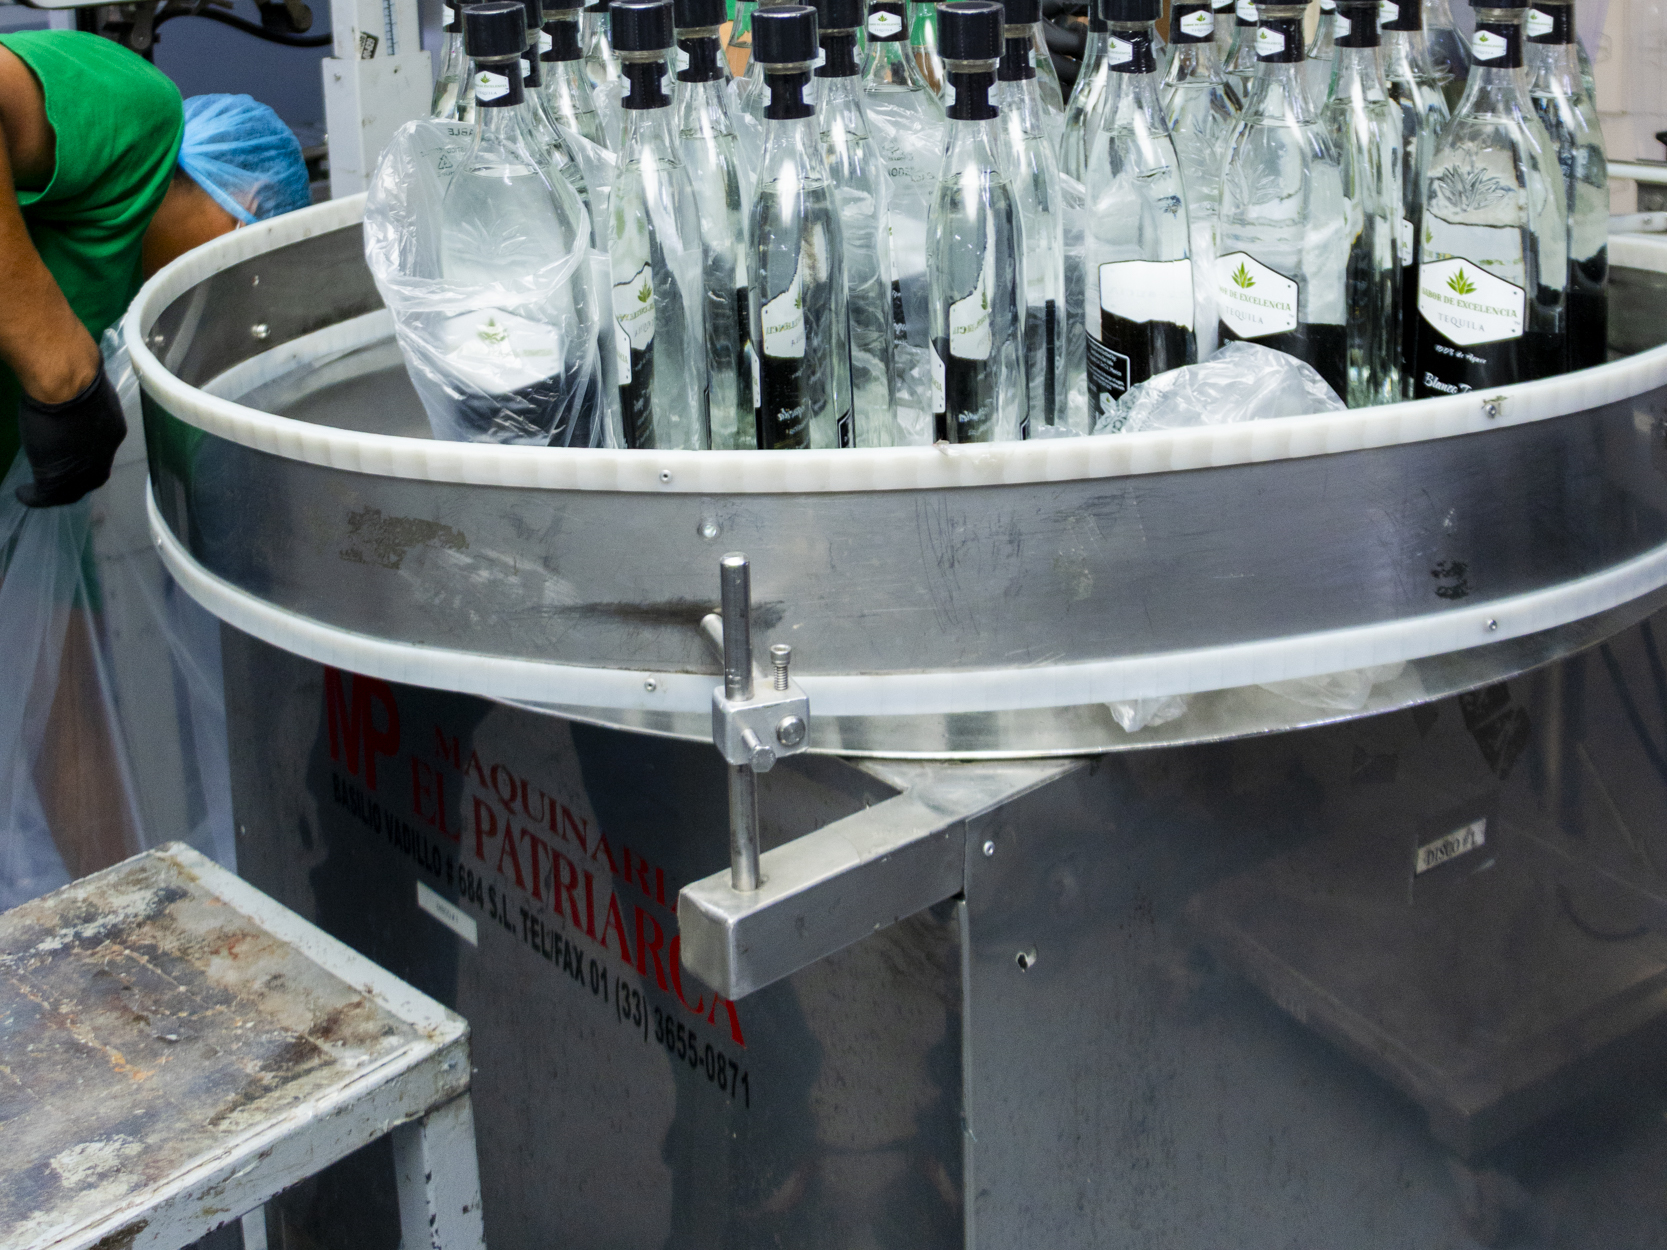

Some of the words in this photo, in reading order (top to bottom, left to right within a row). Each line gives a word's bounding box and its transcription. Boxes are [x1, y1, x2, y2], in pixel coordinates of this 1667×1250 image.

[1239, 293, 1292, 312] EXCELENCIA
[1443, 295, 1456, 306] DE
[1456, 296, 1518, 318] EXCELENCIA
[1226, 306, 1264, 325] TEQUILA
[1437, 312, 1485, 332] TEQUILA
[1424, 371, 1458, 394] Blanco
[324, 664, 400, 792] MP
[411, 754, 461, 845] EL
[434, 725, 680, 916] MAQUINARI
[332, 772, 382, 835] BASILIO
[384, 809, 442, 878] VADILLO
[458, 862, 484, 910] 684
[487, 884, 516, 934] S.L.
[590, 958, 609, 1003] 01
[615, 976, 648, 1043] (33)
[654, 1006, 750, 1109] 3655-0871
